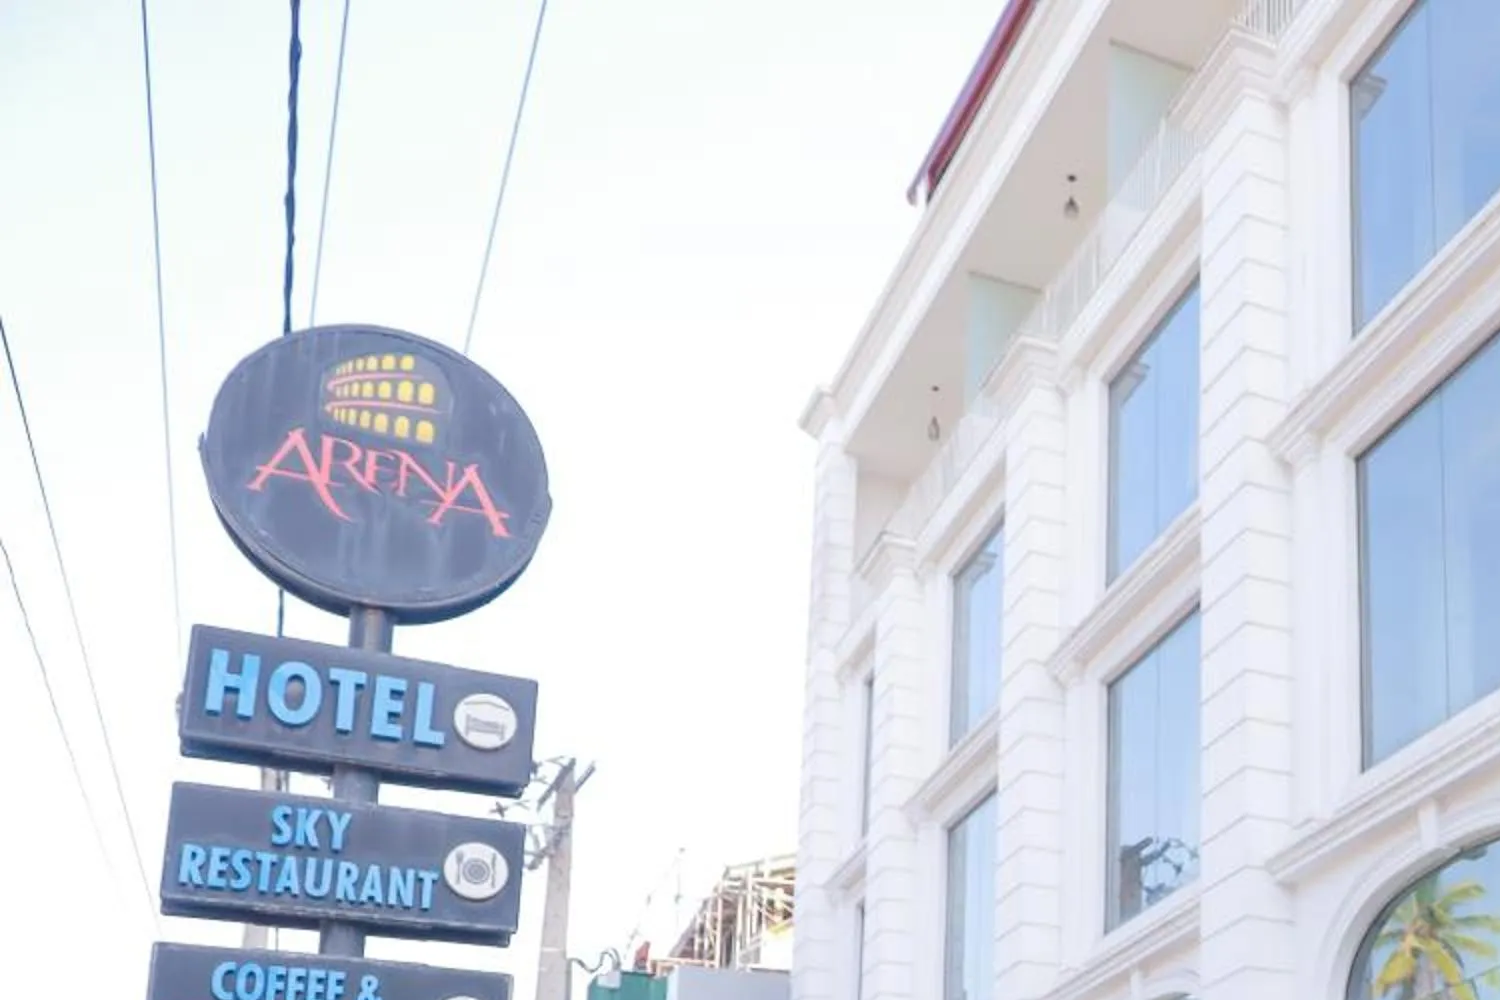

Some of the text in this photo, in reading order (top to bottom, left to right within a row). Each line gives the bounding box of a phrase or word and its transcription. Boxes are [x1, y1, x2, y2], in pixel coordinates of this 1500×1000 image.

[245, 427, 512, 537] ARENA
[205, 648, 447, 748] HOTEL
[271, 805, 352, 851] SKY
[179, 843, 438, 910] RESTAURANT
